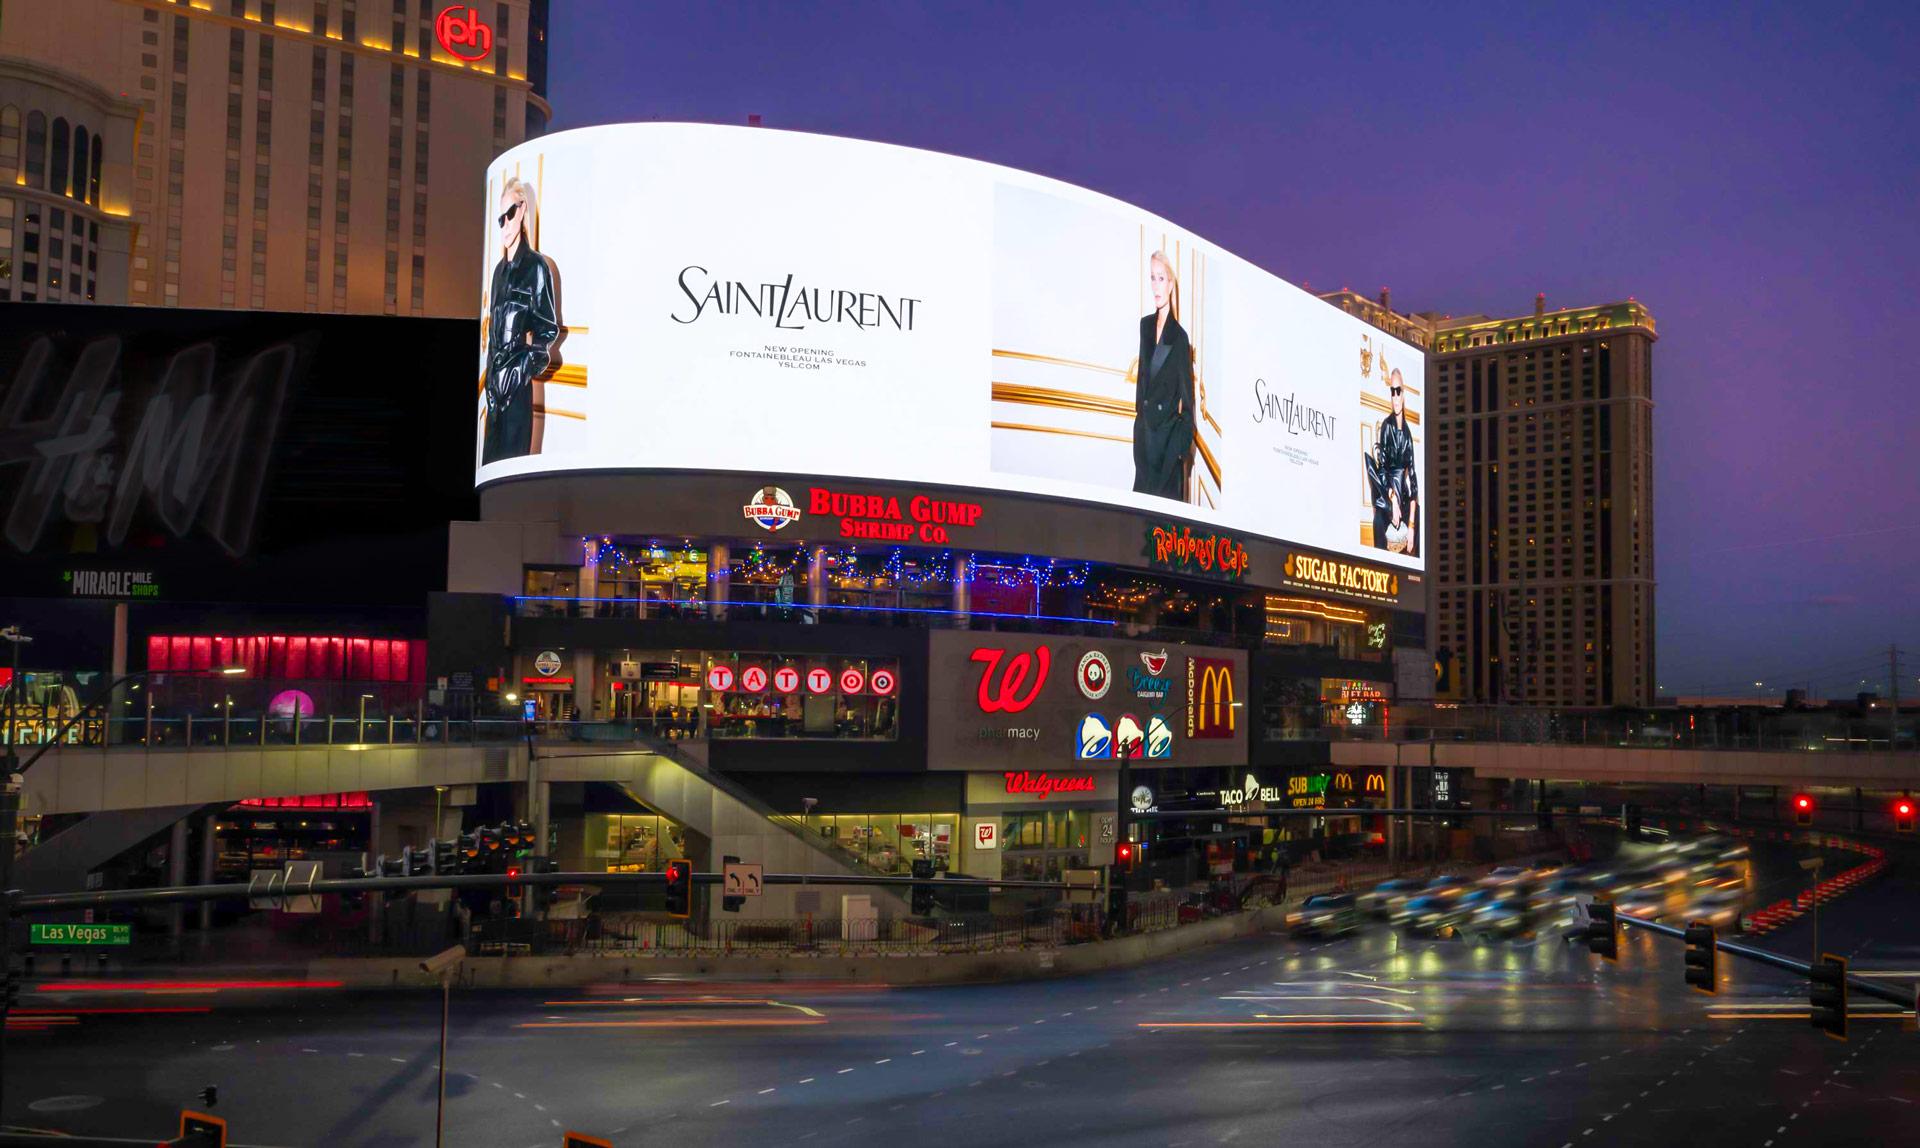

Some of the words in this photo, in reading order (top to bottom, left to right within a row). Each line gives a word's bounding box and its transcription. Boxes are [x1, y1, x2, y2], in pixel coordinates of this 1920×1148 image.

[729, 351, 812, 363] FONTAINEBLEAU
[814, 356, 833, 365] LAS
[835, 358, 867, 367] VEGAS
[764, 345, 788, 353] NEW
[789, 347, 835, 356] OPENING
[778, 361, 820, 370] YSL.COM
[808, 487, 902, 521] BUBBA
[909, 495, 984, 527] GUMP
[839, 518, 915, 542] SHRIMP
[919, 523, 949, 544] CO.
[72, 570, 131, 596] MIRACLE
[131, 572, 153, 584] MILE
[1295, 555, 1337, 585] SUGAR
[1339, 564, 1390, 594] FACTORY
[131, 584, 159, 596] SHOPS
[711, 666, 893, 693] TATTOO
[1003, 771, 1097, 800] Walgreens
[1219, 789, 1243, 805] TACO
[1260, 787, 1280, 802] BELL
[1102, 824, 1113, 837] 24
[42, 924, 64, 939] Las
[68, 924, 107, 944] Vegas
